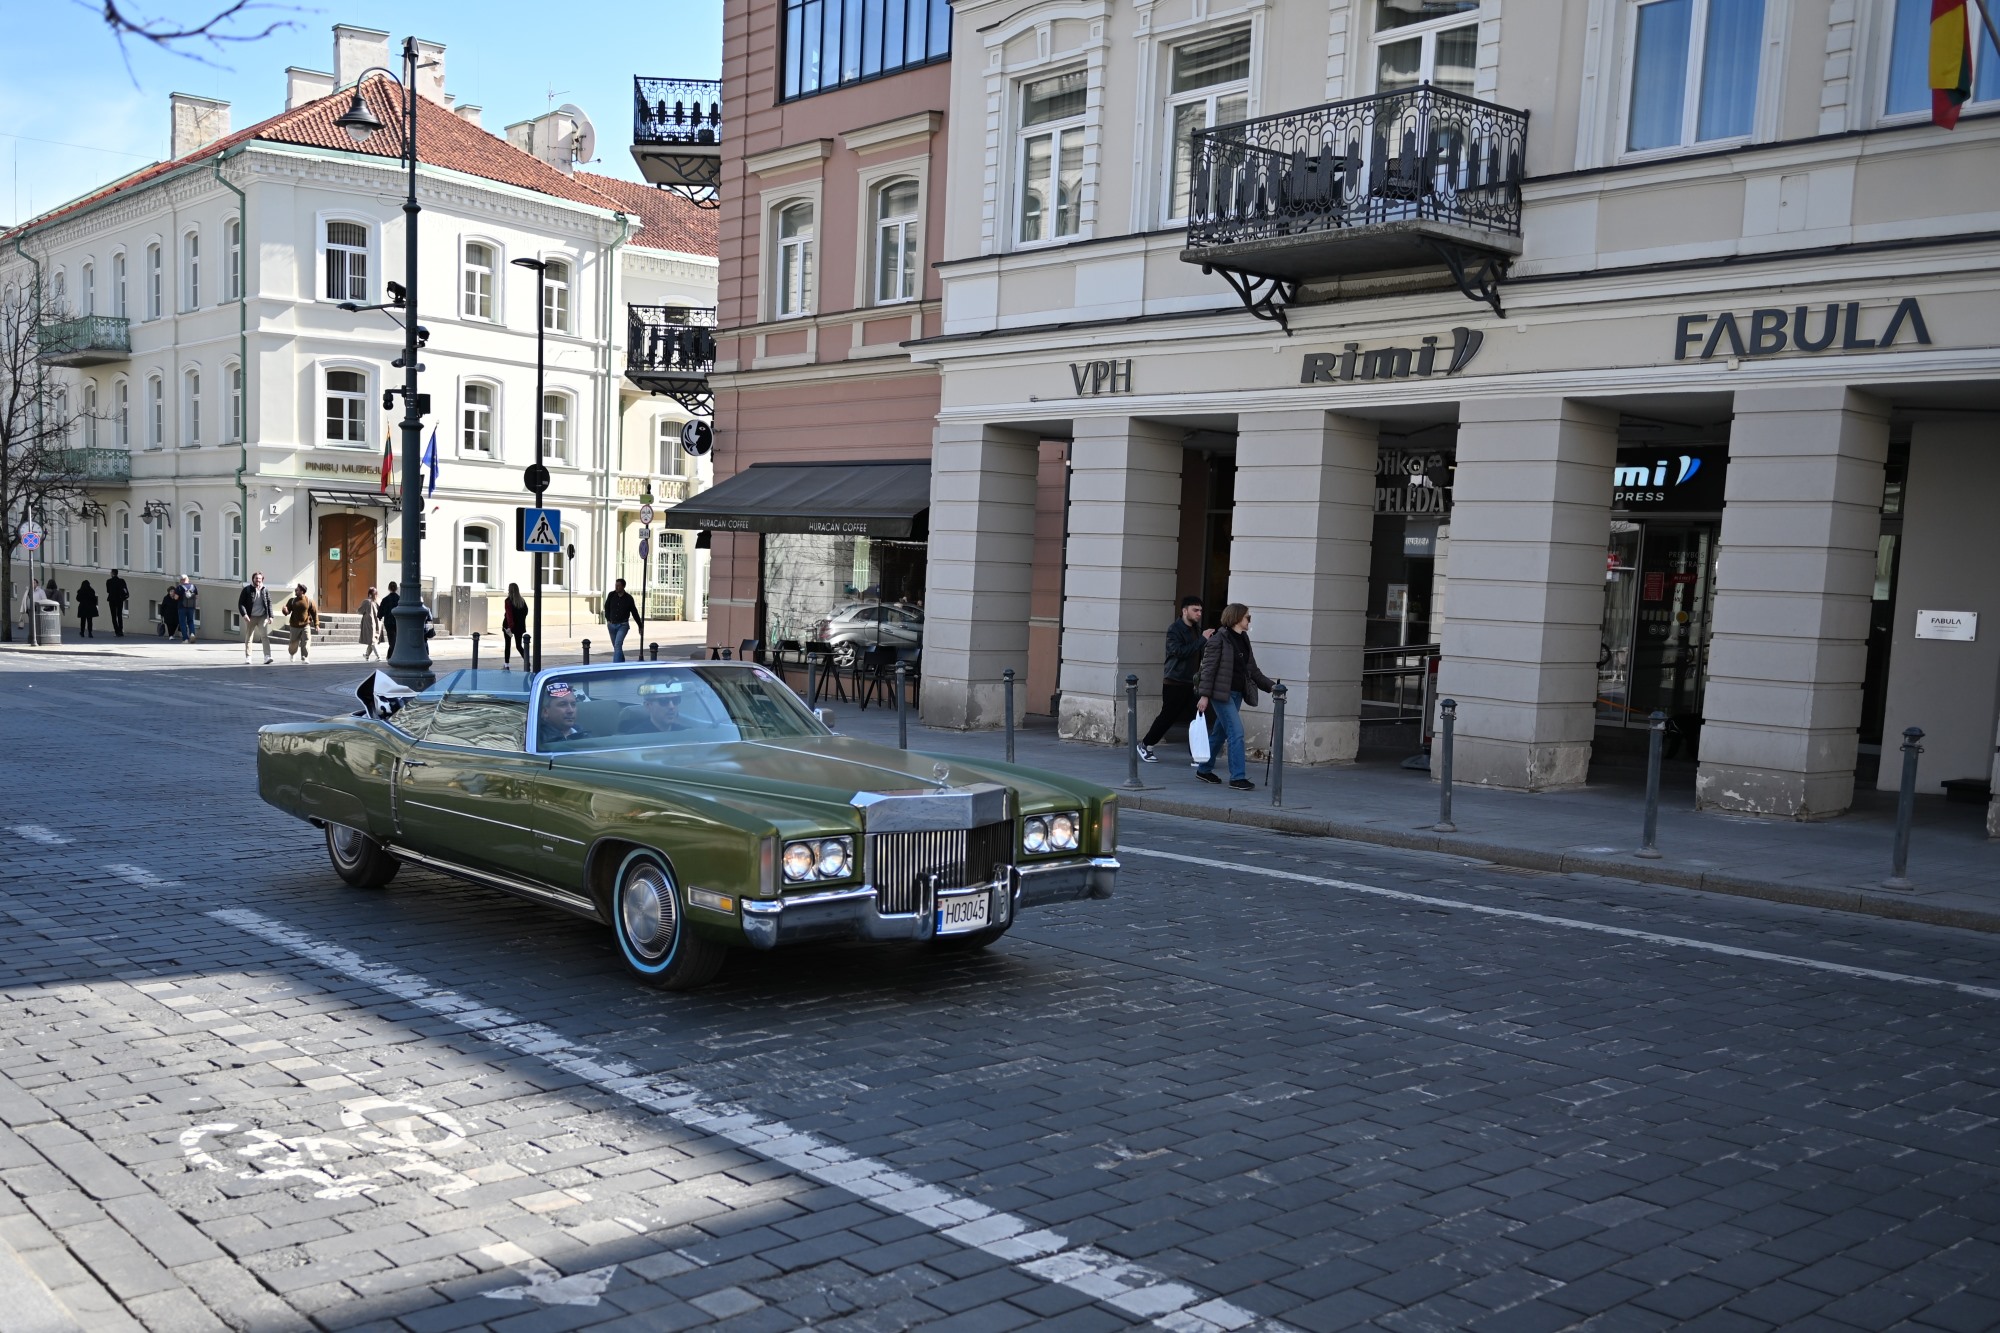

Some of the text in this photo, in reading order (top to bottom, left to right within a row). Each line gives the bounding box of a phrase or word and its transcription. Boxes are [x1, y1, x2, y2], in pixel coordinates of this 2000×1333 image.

[1674, 297, 1932, 360] FABULA
[1300, 336, 1438, 384] Rimi
[1069, 359, 1132, 396] VPH
[341, 463, 383, 475] MUZIEJU
[1613, 460, 1668, 487] mi
[1615, 492, 1665, 502] PRESS
[272, 505, 277, 514] 2
[728, 519, 749, 529] COFFEE
[842, 522, 867, 533] COFFEE
[1931, 617, 1962, 625] FABULA
[946, 900, 985, 924] H03045
